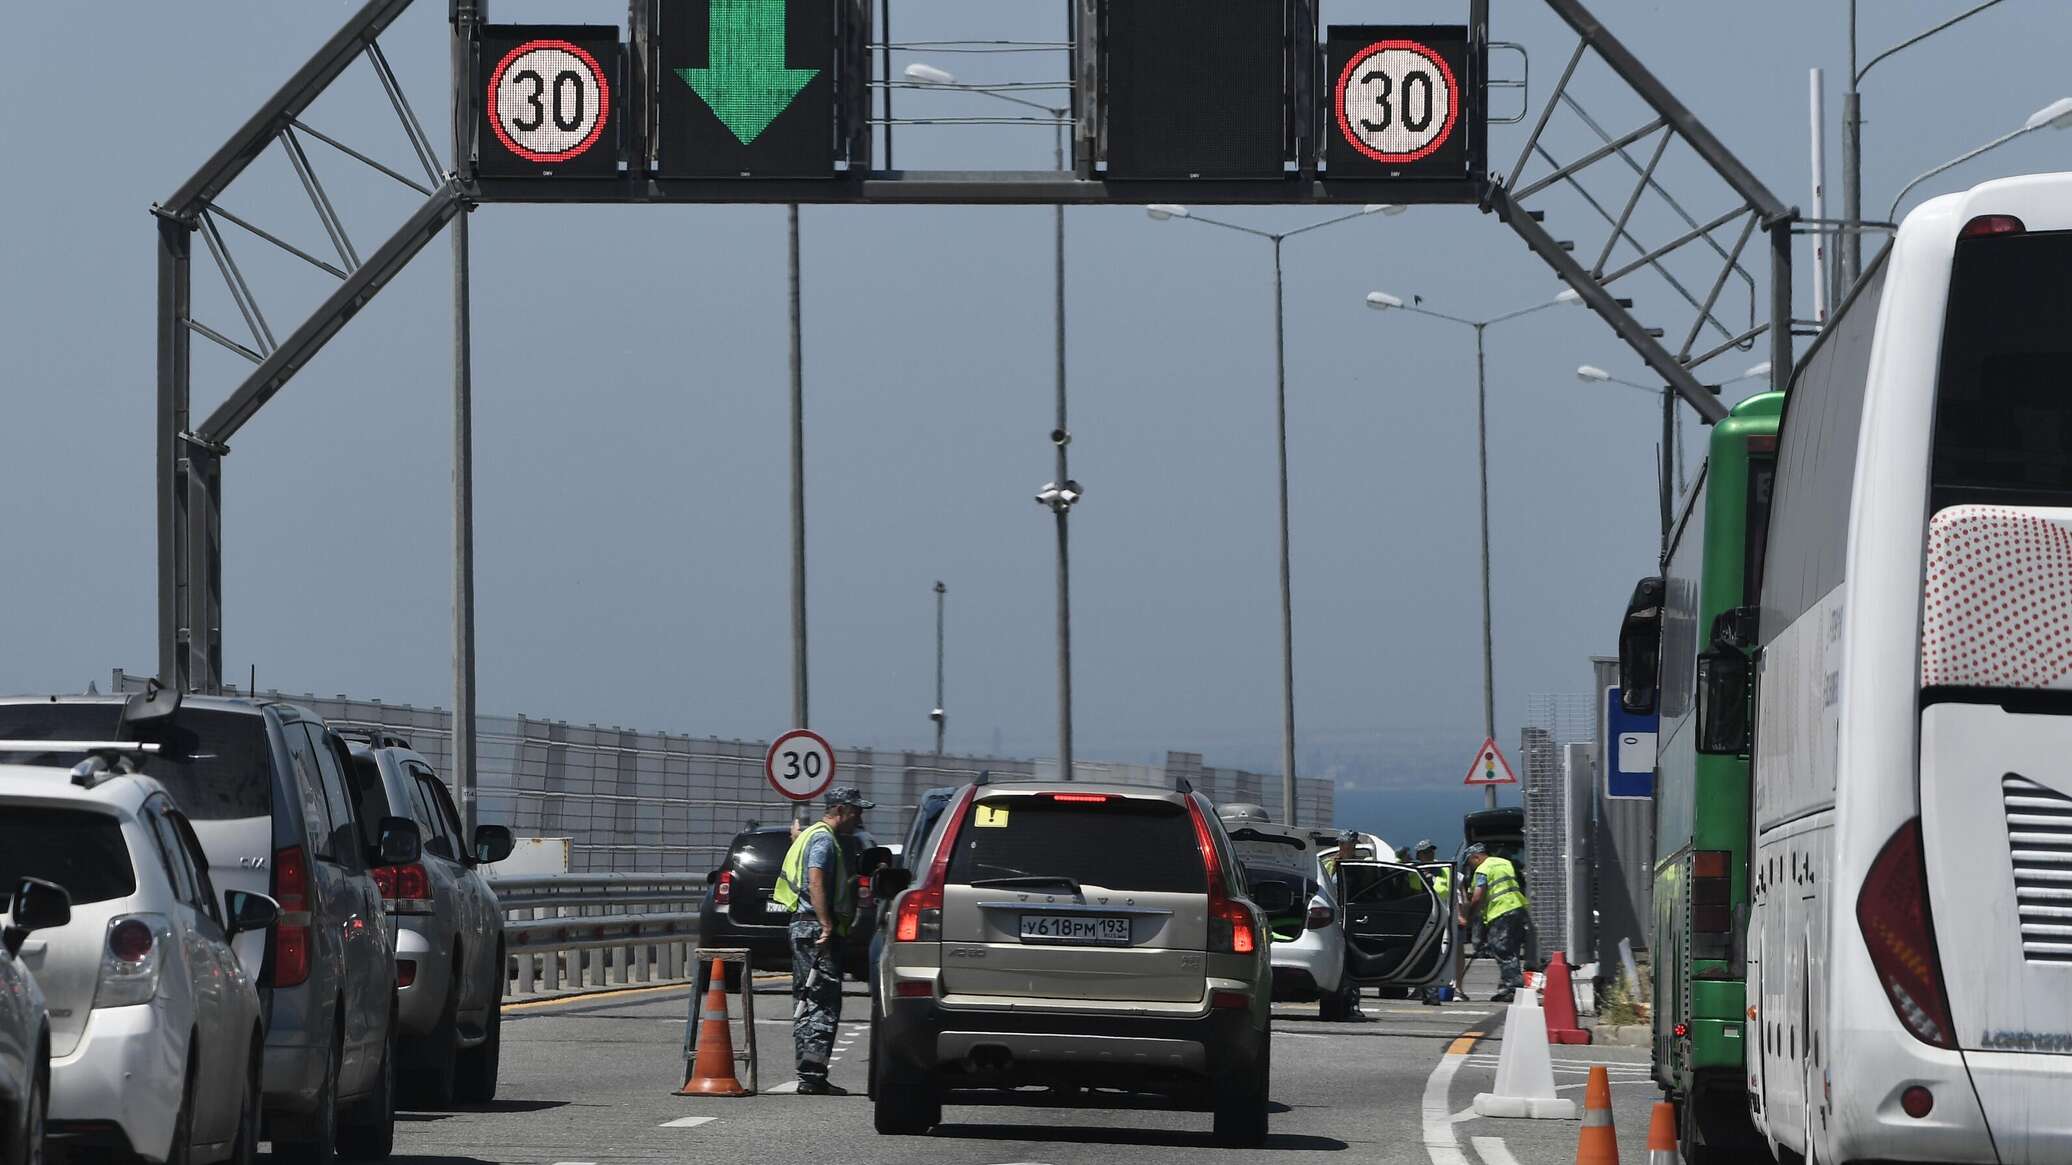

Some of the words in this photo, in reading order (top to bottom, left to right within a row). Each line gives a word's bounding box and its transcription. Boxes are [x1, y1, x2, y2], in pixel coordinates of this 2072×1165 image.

[513, 70, 584, 132] 30
[1360, 71, 1433, 132] 30
[783, 751, 821, 780] 30
[1099, 919, 1124, 933] 193
